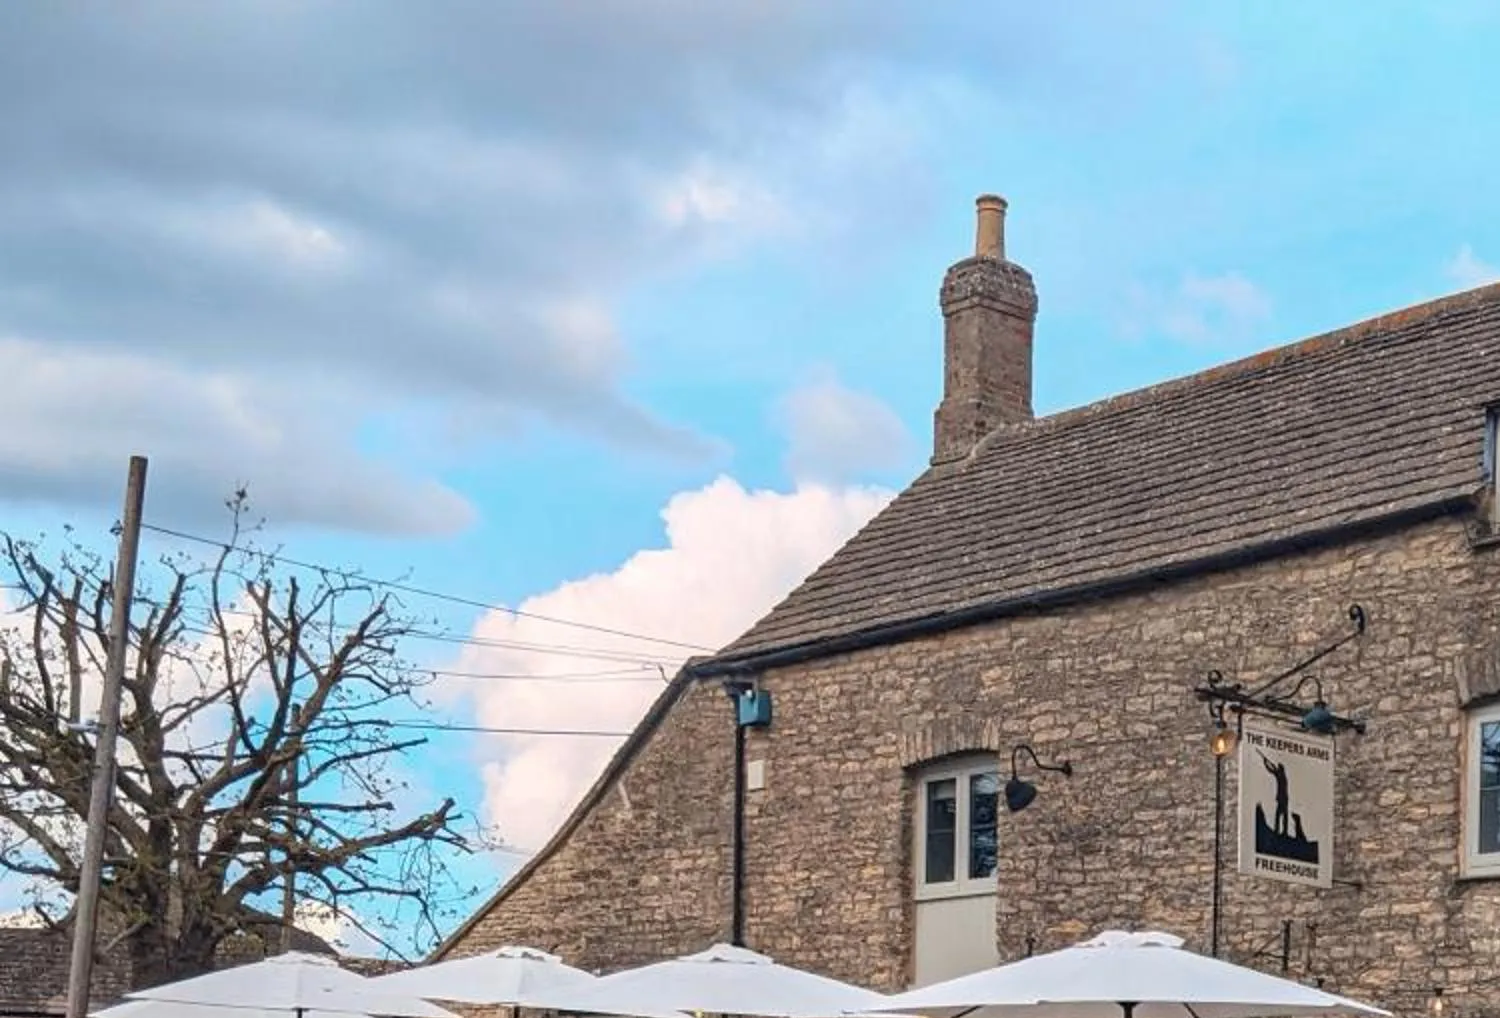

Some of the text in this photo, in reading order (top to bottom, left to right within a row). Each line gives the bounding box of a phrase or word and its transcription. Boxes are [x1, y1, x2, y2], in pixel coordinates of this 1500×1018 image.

[1246, 731, 1329, 761] THE KEEPERS ARMS
[1255, 857, 1319, 880] FREEHOUSE
